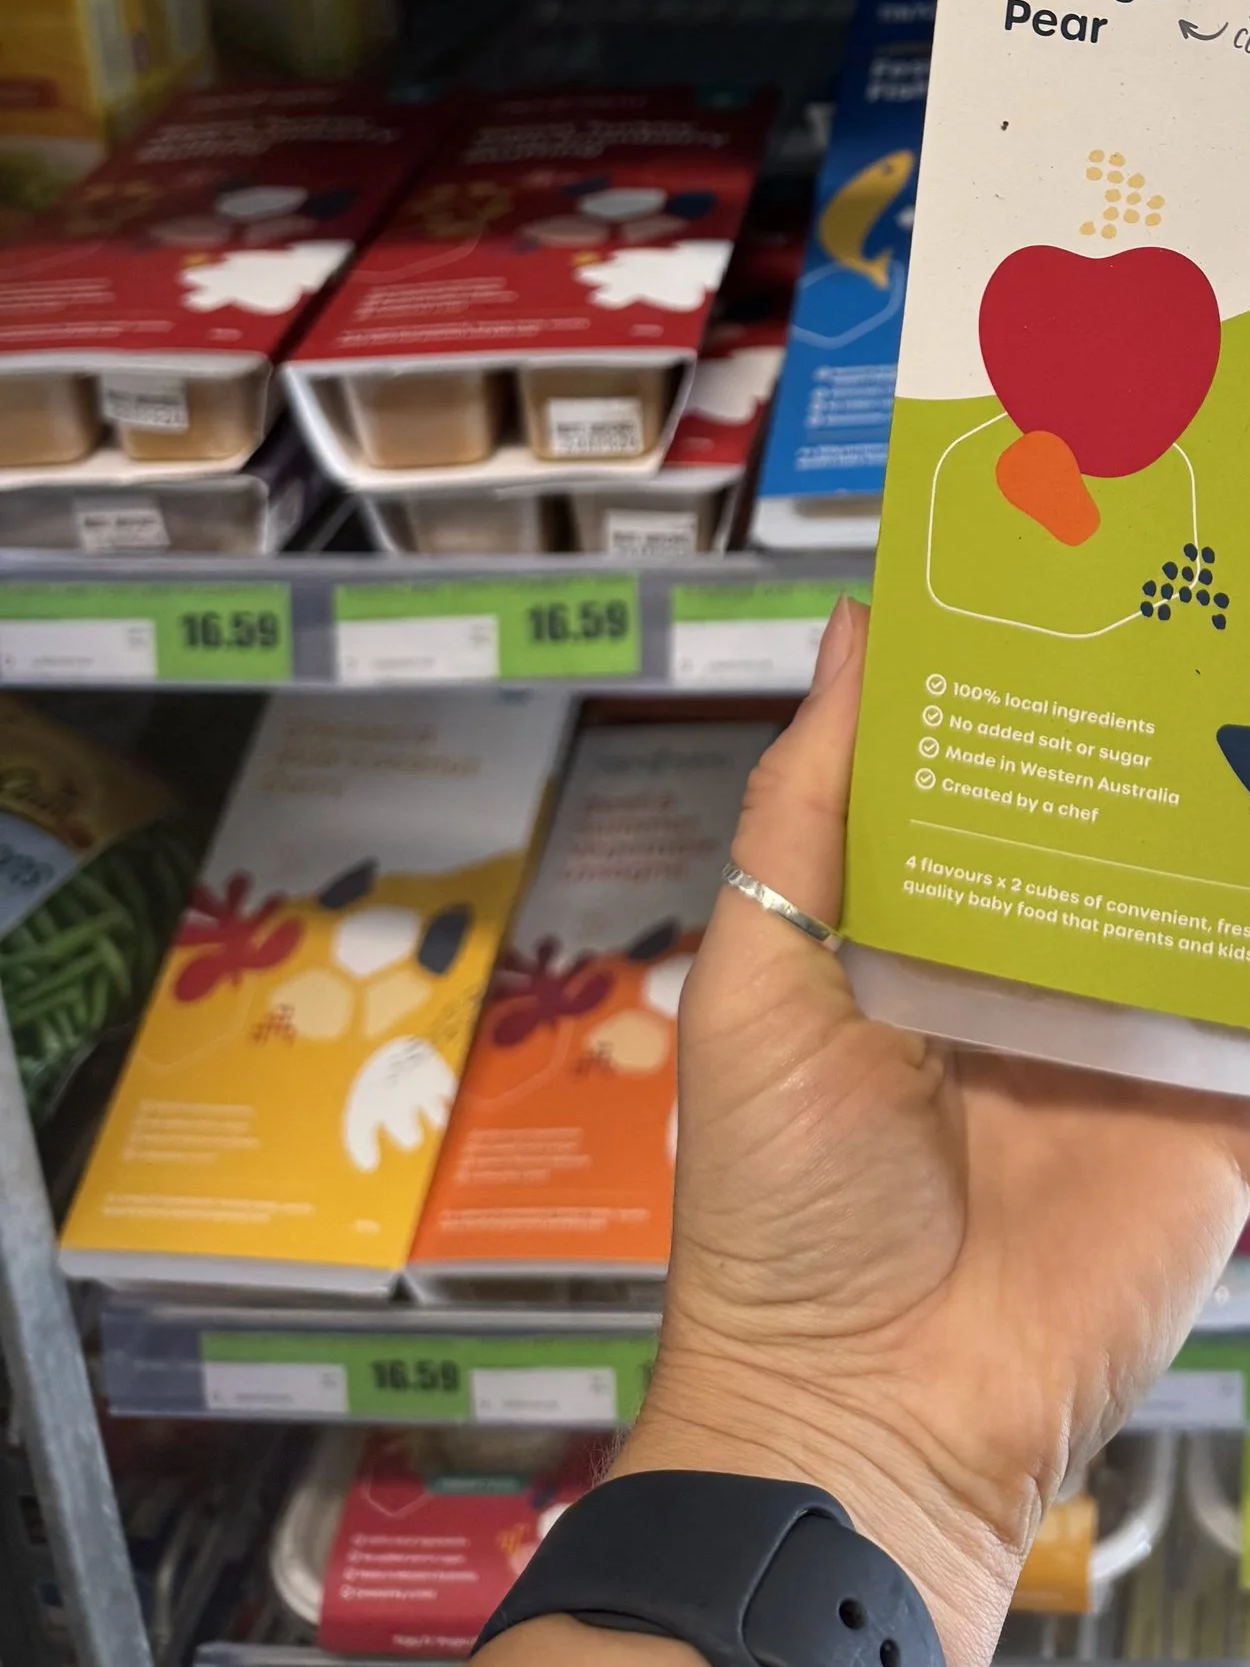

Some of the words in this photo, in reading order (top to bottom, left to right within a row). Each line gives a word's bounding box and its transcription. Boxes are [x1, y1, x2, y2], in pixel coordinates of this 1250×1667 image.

[180, 610, 280, 651] 16.59
[526, 600, 630, 643] 16.59
[952, 681, 1001, 705] 100%
[1004, 691, 1049, 714] local
[1051, 700, 1156, 735] ingredients
[949, 714, 973, 733] No
[977, 720, 1034, 745] added
[1038, 734, 1072, 754] salt
[1076, 742, 1096, 758] or
[1098, 746, 1152, 770] sugar
[941, 776, 1013, 806] Created
[1016, 792, 1039, 814] by
[1042, 800, 1054, 815] a
[1057, 803, 1100, 824] chef
[945, 743, 997, 769] Made
[1000, 755, 1017, 773] in
[1020, 759, 1094, 791] Western
[1097, 775, 1181, 807] Australia
[902, 877, 965, 908] quality
[967, 888, 1014, 916] baby
[1016, 899, 1059, 924] food
[1061, 910, 1101, 933] that
[1102, 918, 1175, 949] parents
[1178, 932, 1215, 956] and
[904, 854, 918, 871] 4
[920, 856, 994, 888] flavours
[997, 874, 1008, 890] x
[1010, 877, 1023, 894] 2
[1025, 880, 1081, 905] cubes
[1083, 891, 1103, 910] of
[1106, 897, 1213, 934] convenient,
[371, 1359, 460, 1393] 16.59
